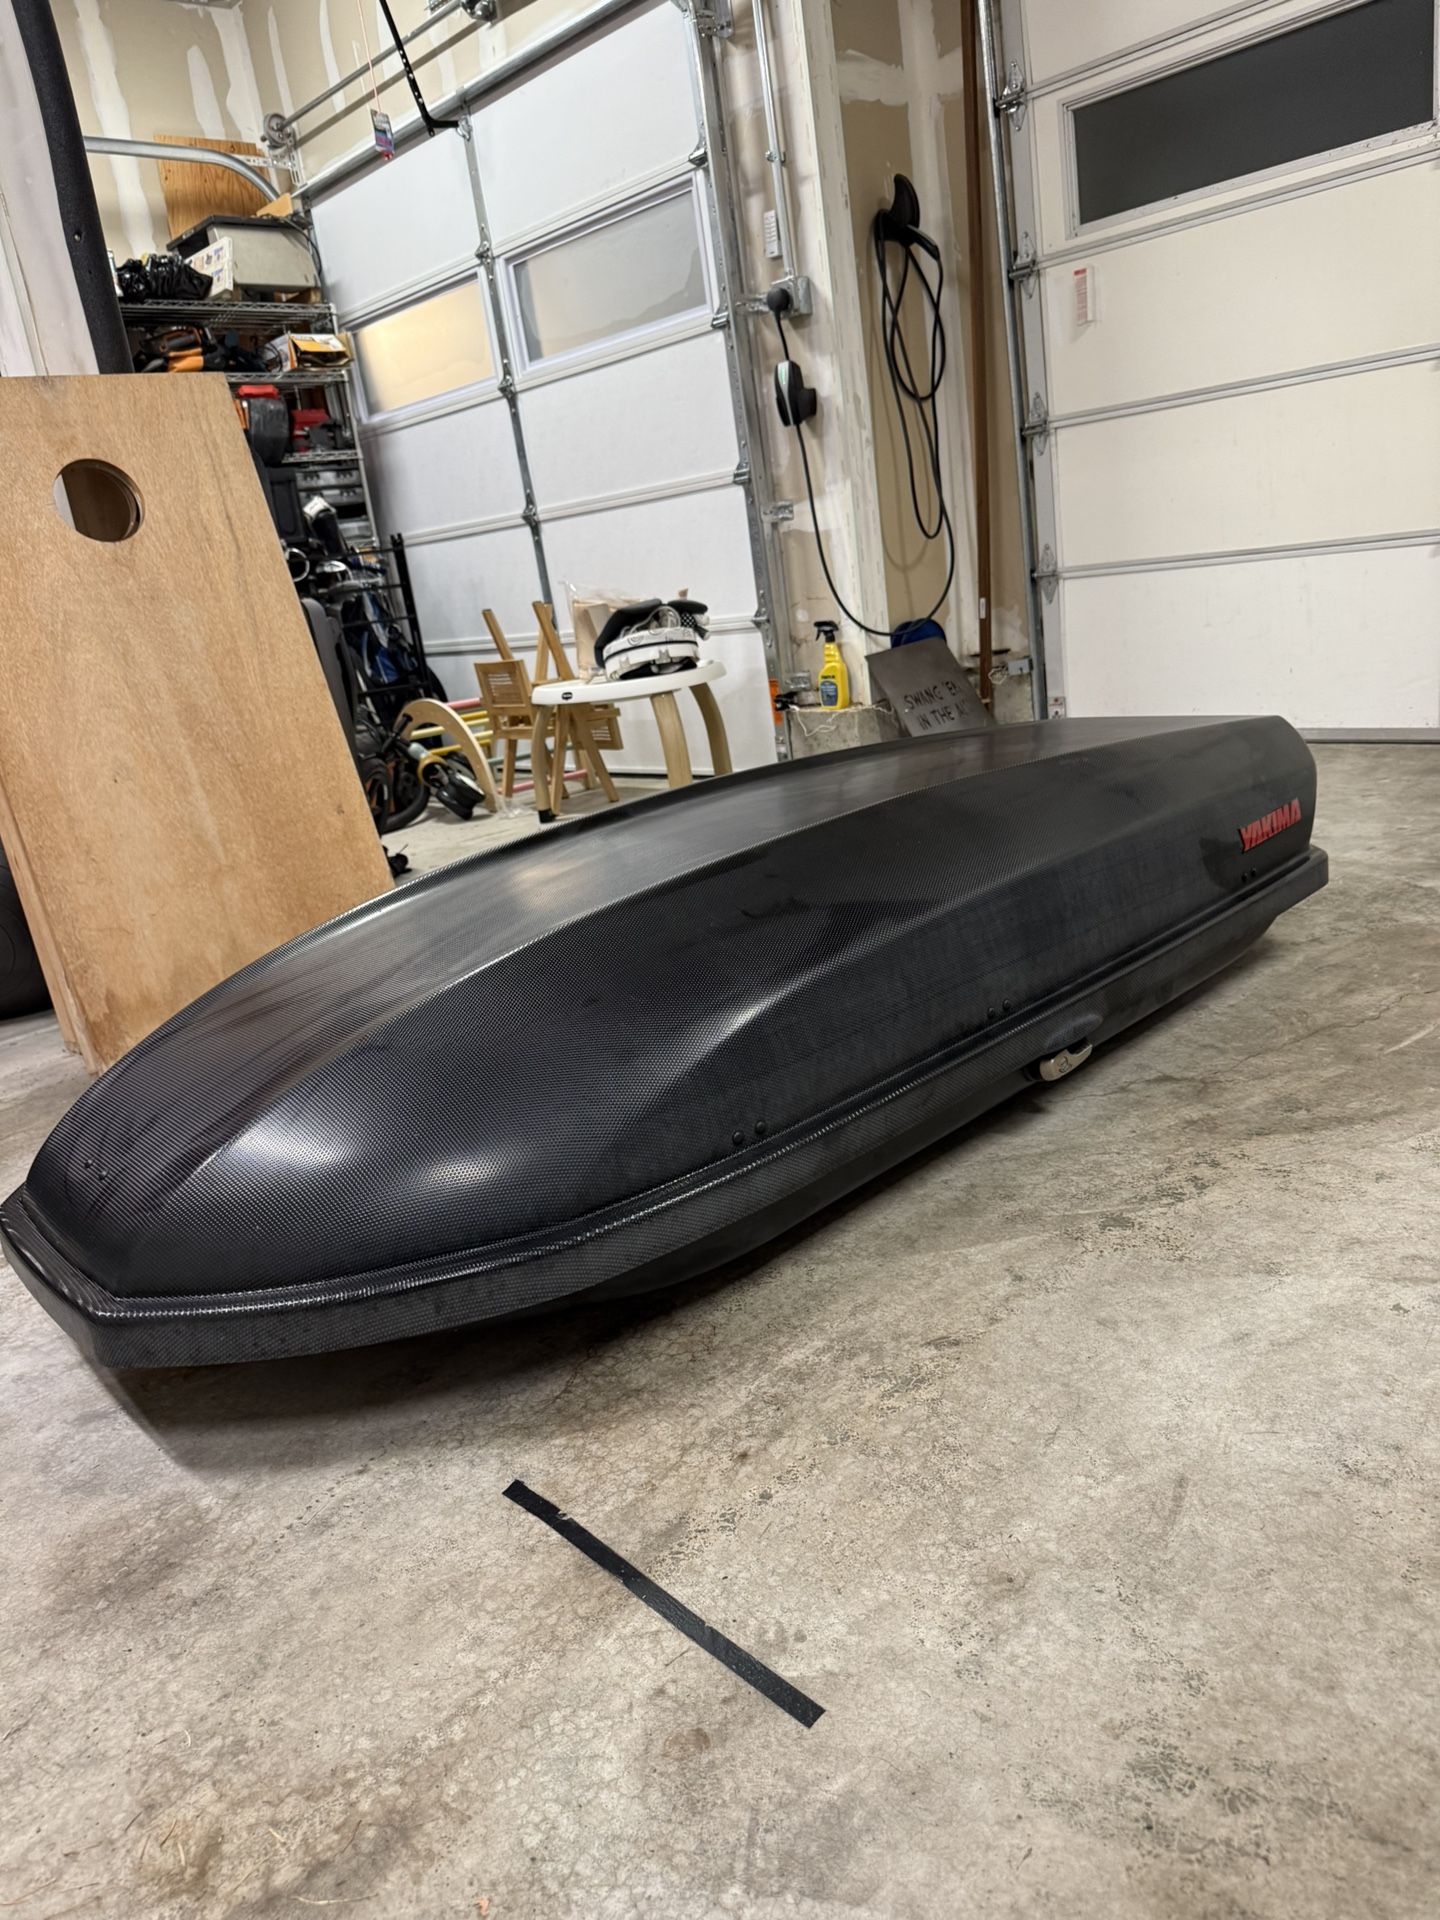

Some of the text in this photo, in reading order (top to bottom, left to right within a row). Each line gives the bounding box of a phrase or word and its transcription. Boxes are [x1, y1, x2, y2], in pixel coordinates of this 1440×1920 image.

[917, 713, 932, 731] IN
[930, 706, 955, 725] THE
[1240, 798, 1302, 852] YAKIMA
